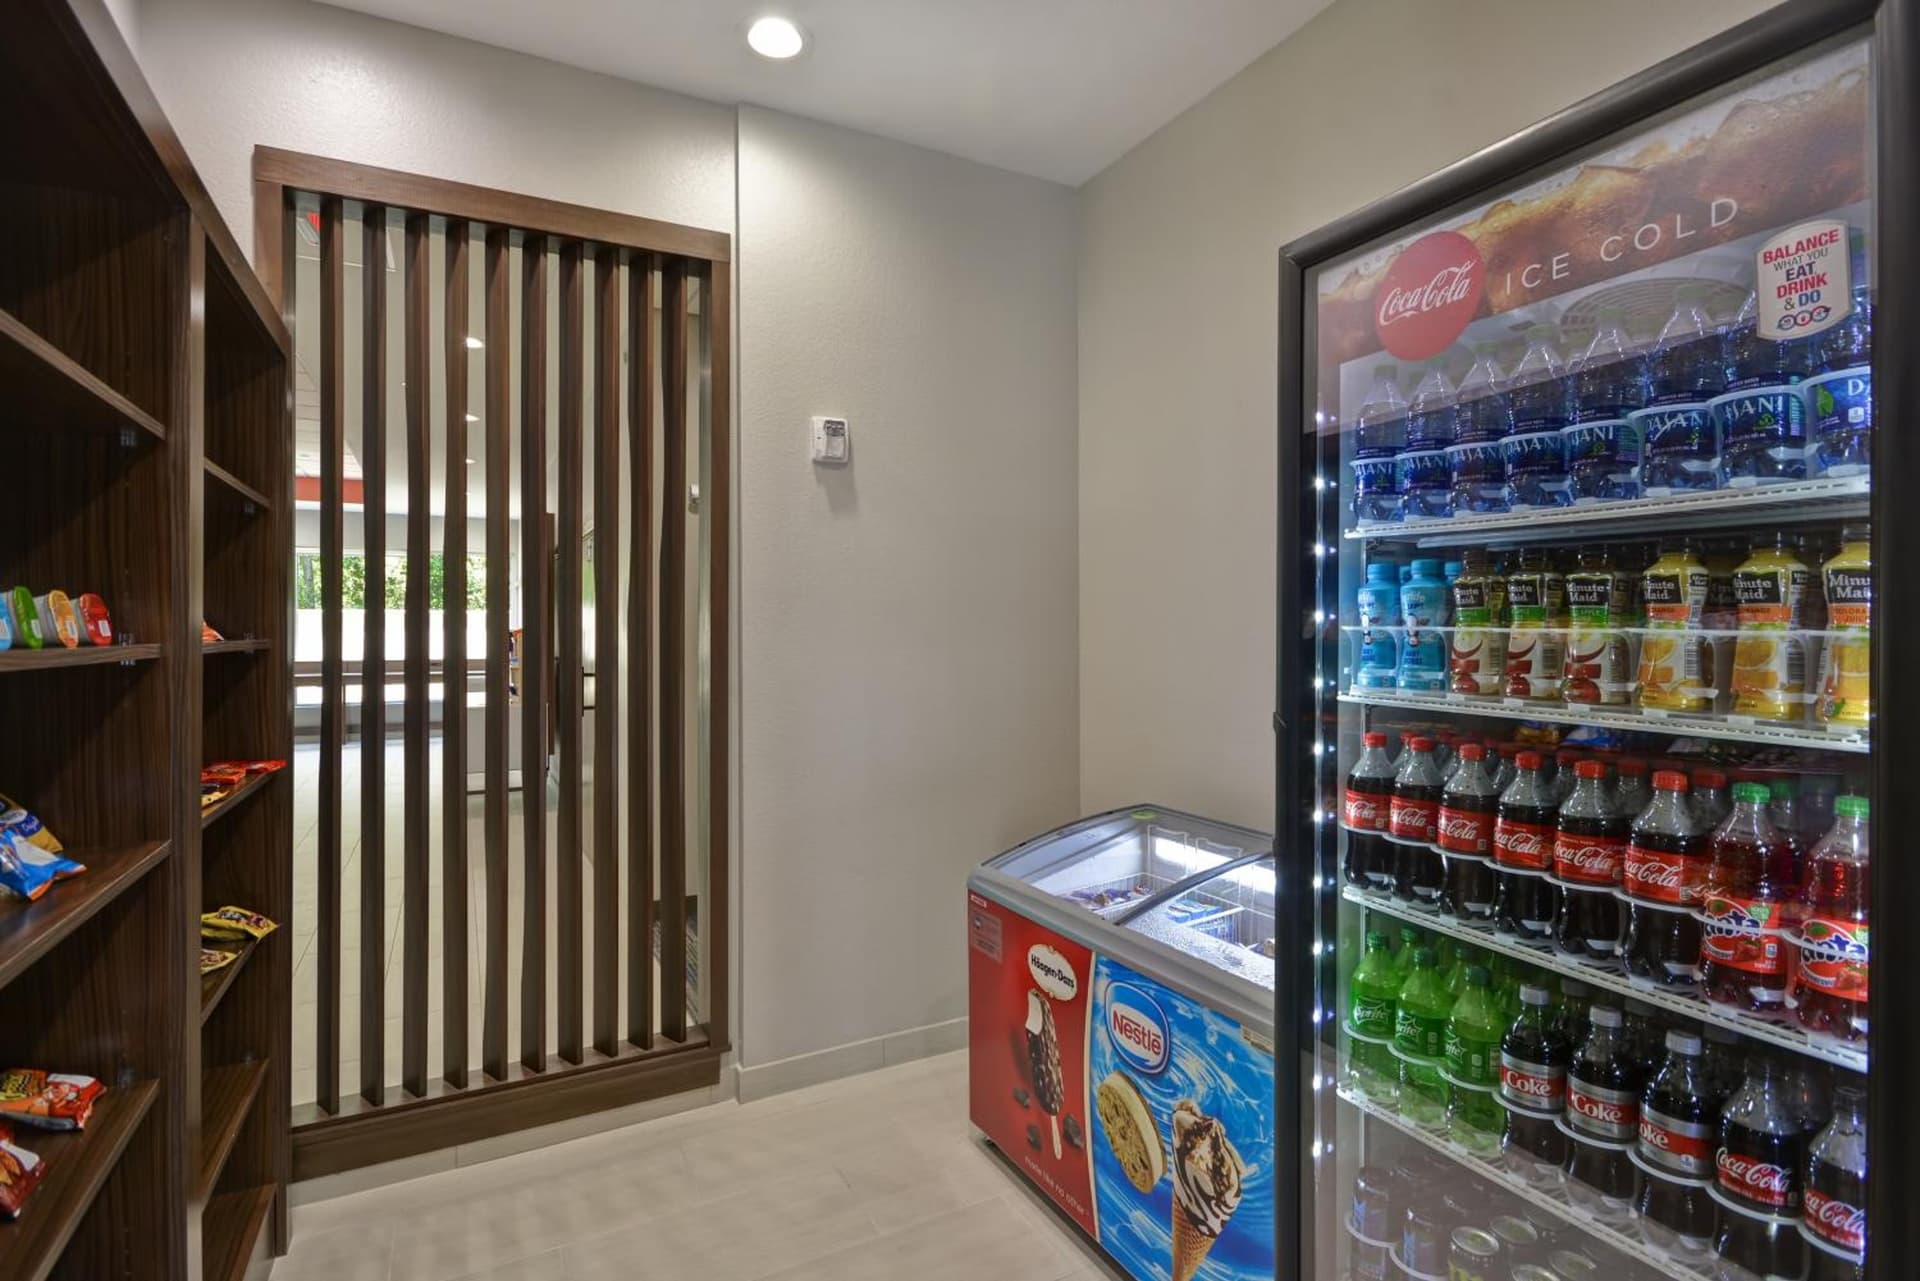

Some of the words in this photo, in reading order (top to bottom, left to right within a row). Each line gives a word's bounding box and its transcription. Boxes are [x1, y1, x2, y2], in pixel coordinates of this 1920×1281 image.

[1505, 253, 1570, 296] ICE
[1600, 197, 1738, 262] COLD
[1763, 228, 1840, 265] BALANCE
[1773, 255, 1803, 272] WHAT
[1806, 247, 1829, 261] YOU
[1379, 259, 1476, 326] Coca-Cola
[1776, 272, 1828, 299] DRINK
[1784, 297, 1796, 311] &
[1798, 289, 1821, 306] DO
[1031, 954, 1075, 988] Häagen-Dazs
[1112, 1008, 1162, 1056] Nestlé
[1507, 1069, 1552, 1097] Coke
[1573, 1094, 1618, 1121] Coke
[1640, 1122, 1669, 1149] oke
[1715, 1146, 1792, 1193] Coca-Cola
